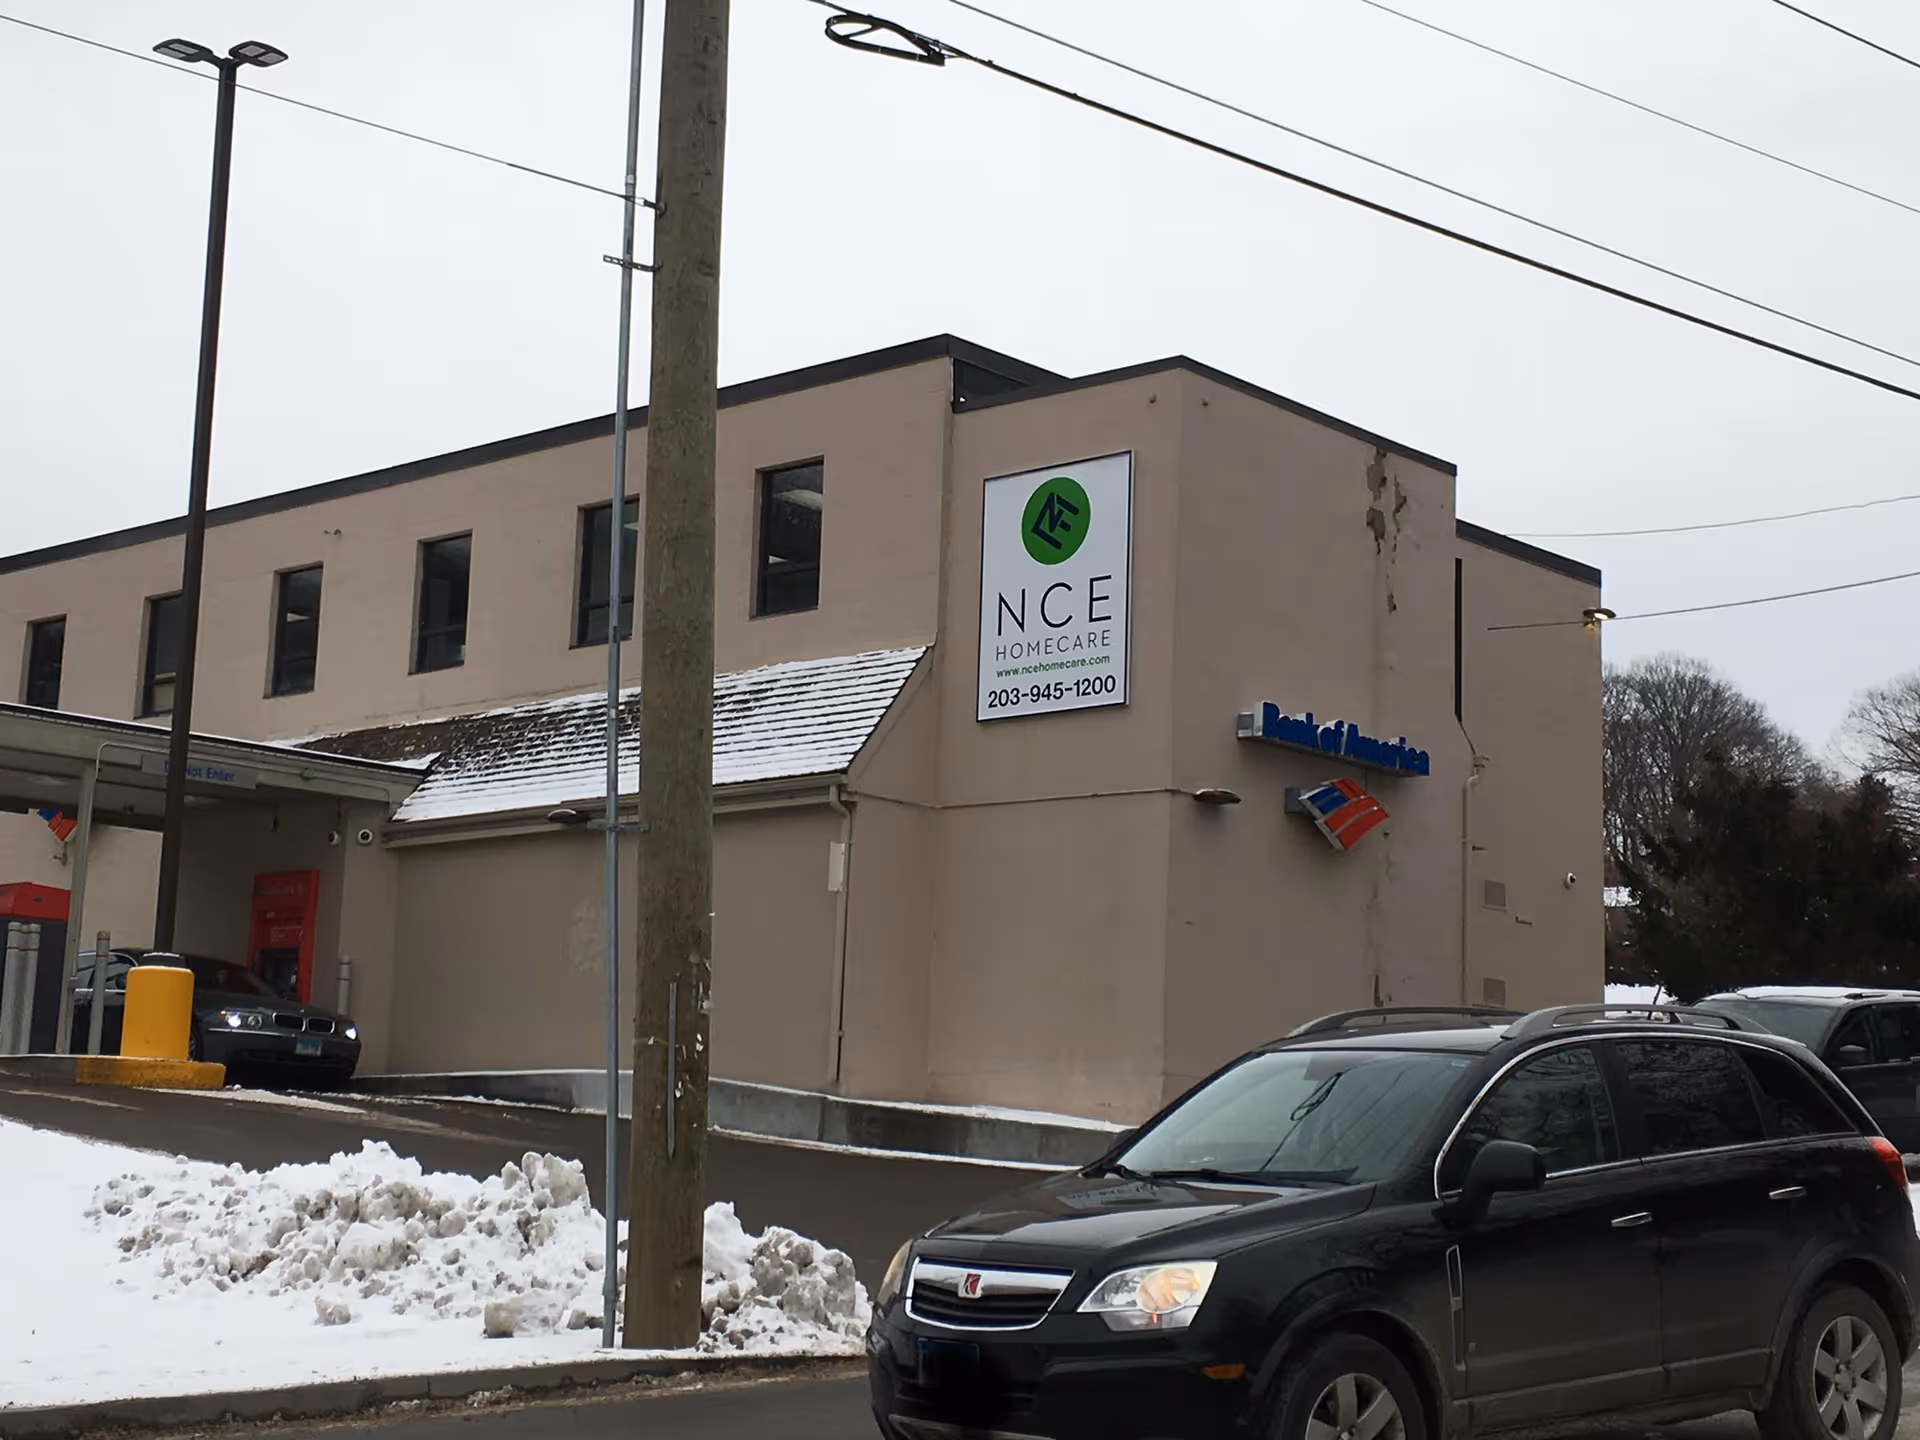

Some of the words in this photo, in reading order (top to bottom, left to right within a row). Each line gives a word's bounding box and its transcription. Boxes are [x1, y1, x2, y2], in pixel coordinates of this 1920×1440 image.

[997, 574, 1112, 637] NCE
[995, 629, 1111, 662] HOMECARE
[995, 655, 1111, 678] www.ncehomecare.com
[987, 674, 1117, 709] 203-945-1200
